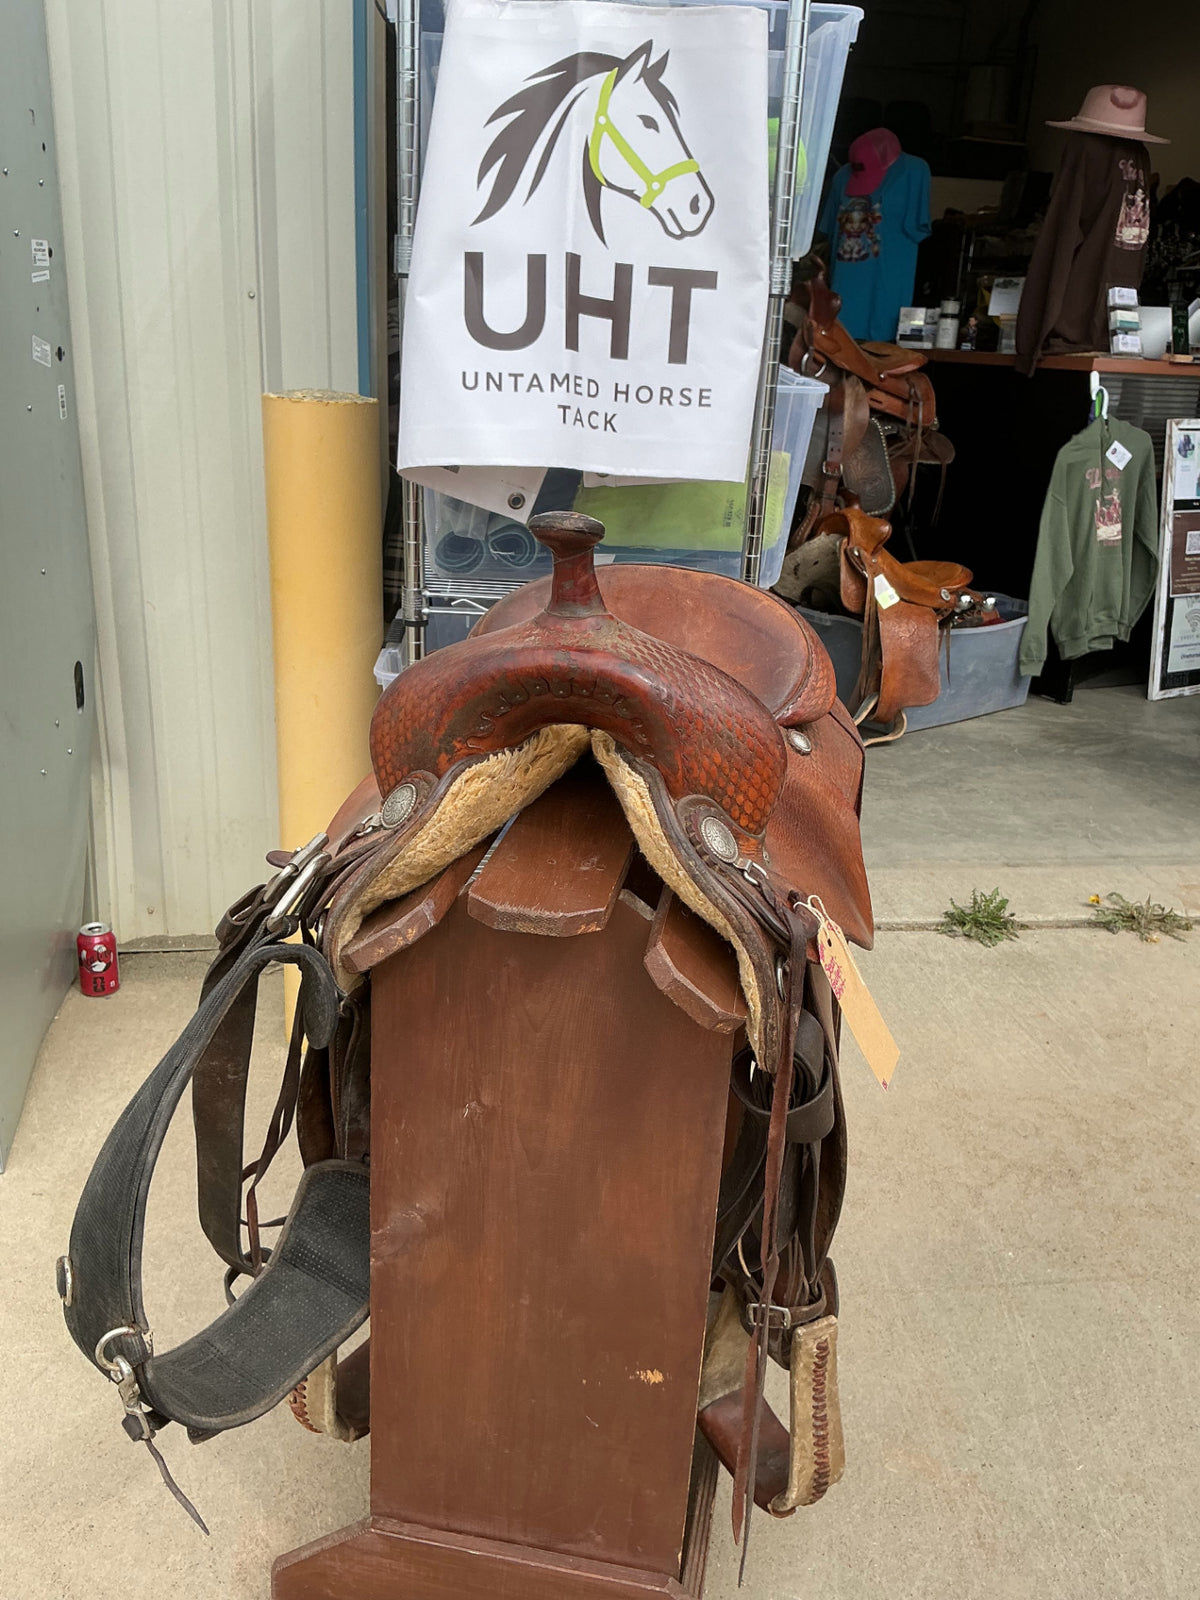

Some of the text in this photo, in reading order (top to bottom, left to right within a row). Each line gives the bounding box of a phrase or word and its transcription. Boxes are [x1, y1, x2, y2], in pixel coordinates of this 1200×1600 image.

[463, 251, 719, 365] UHT
[461, 371, 713, 408] UNTAMED HORSE
[557, 404, 618, 433] TACK
